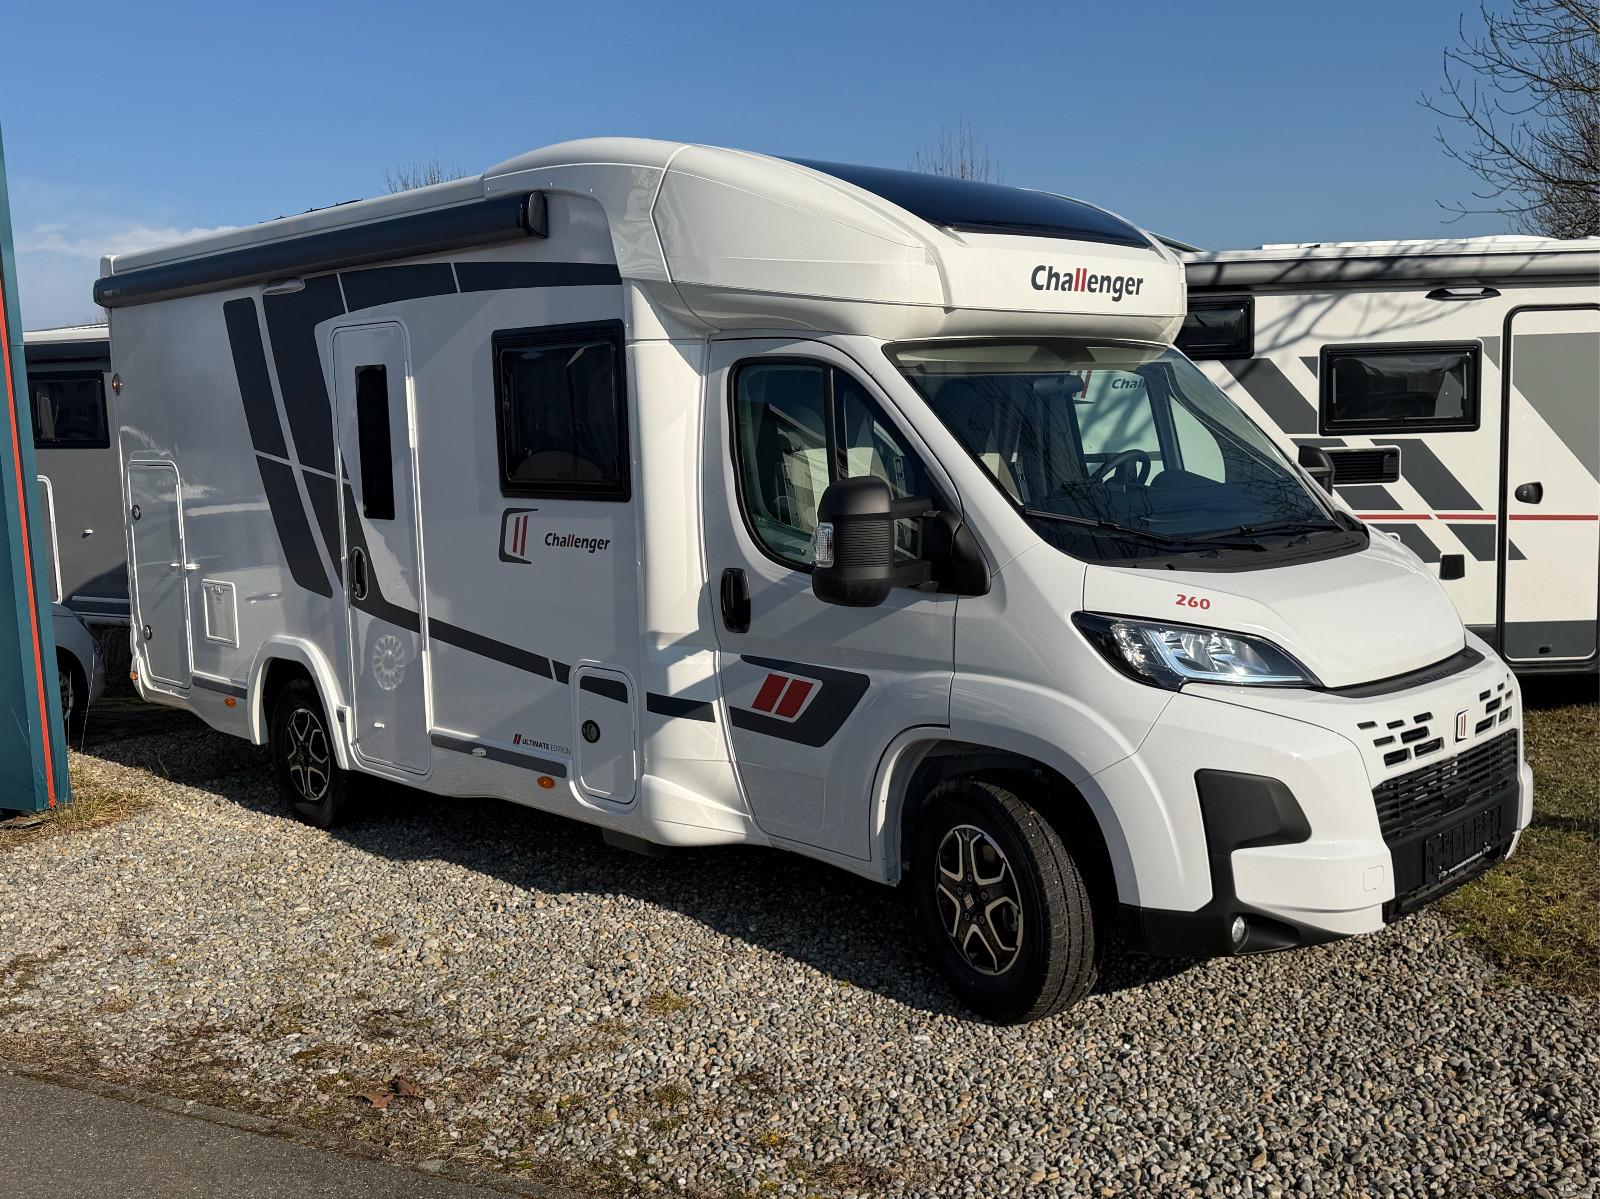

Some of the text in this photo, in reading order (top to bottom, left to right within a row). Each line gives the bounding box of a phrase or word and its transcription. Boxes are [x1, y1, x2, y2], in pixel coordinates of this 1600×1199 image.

[1031, 264, 1144, 302] Challenger
[544, 532, 611, 553] Challenger
[1175, 593, 1211, 610] 260
[522, 738, 550, 750] ULTIMATE
